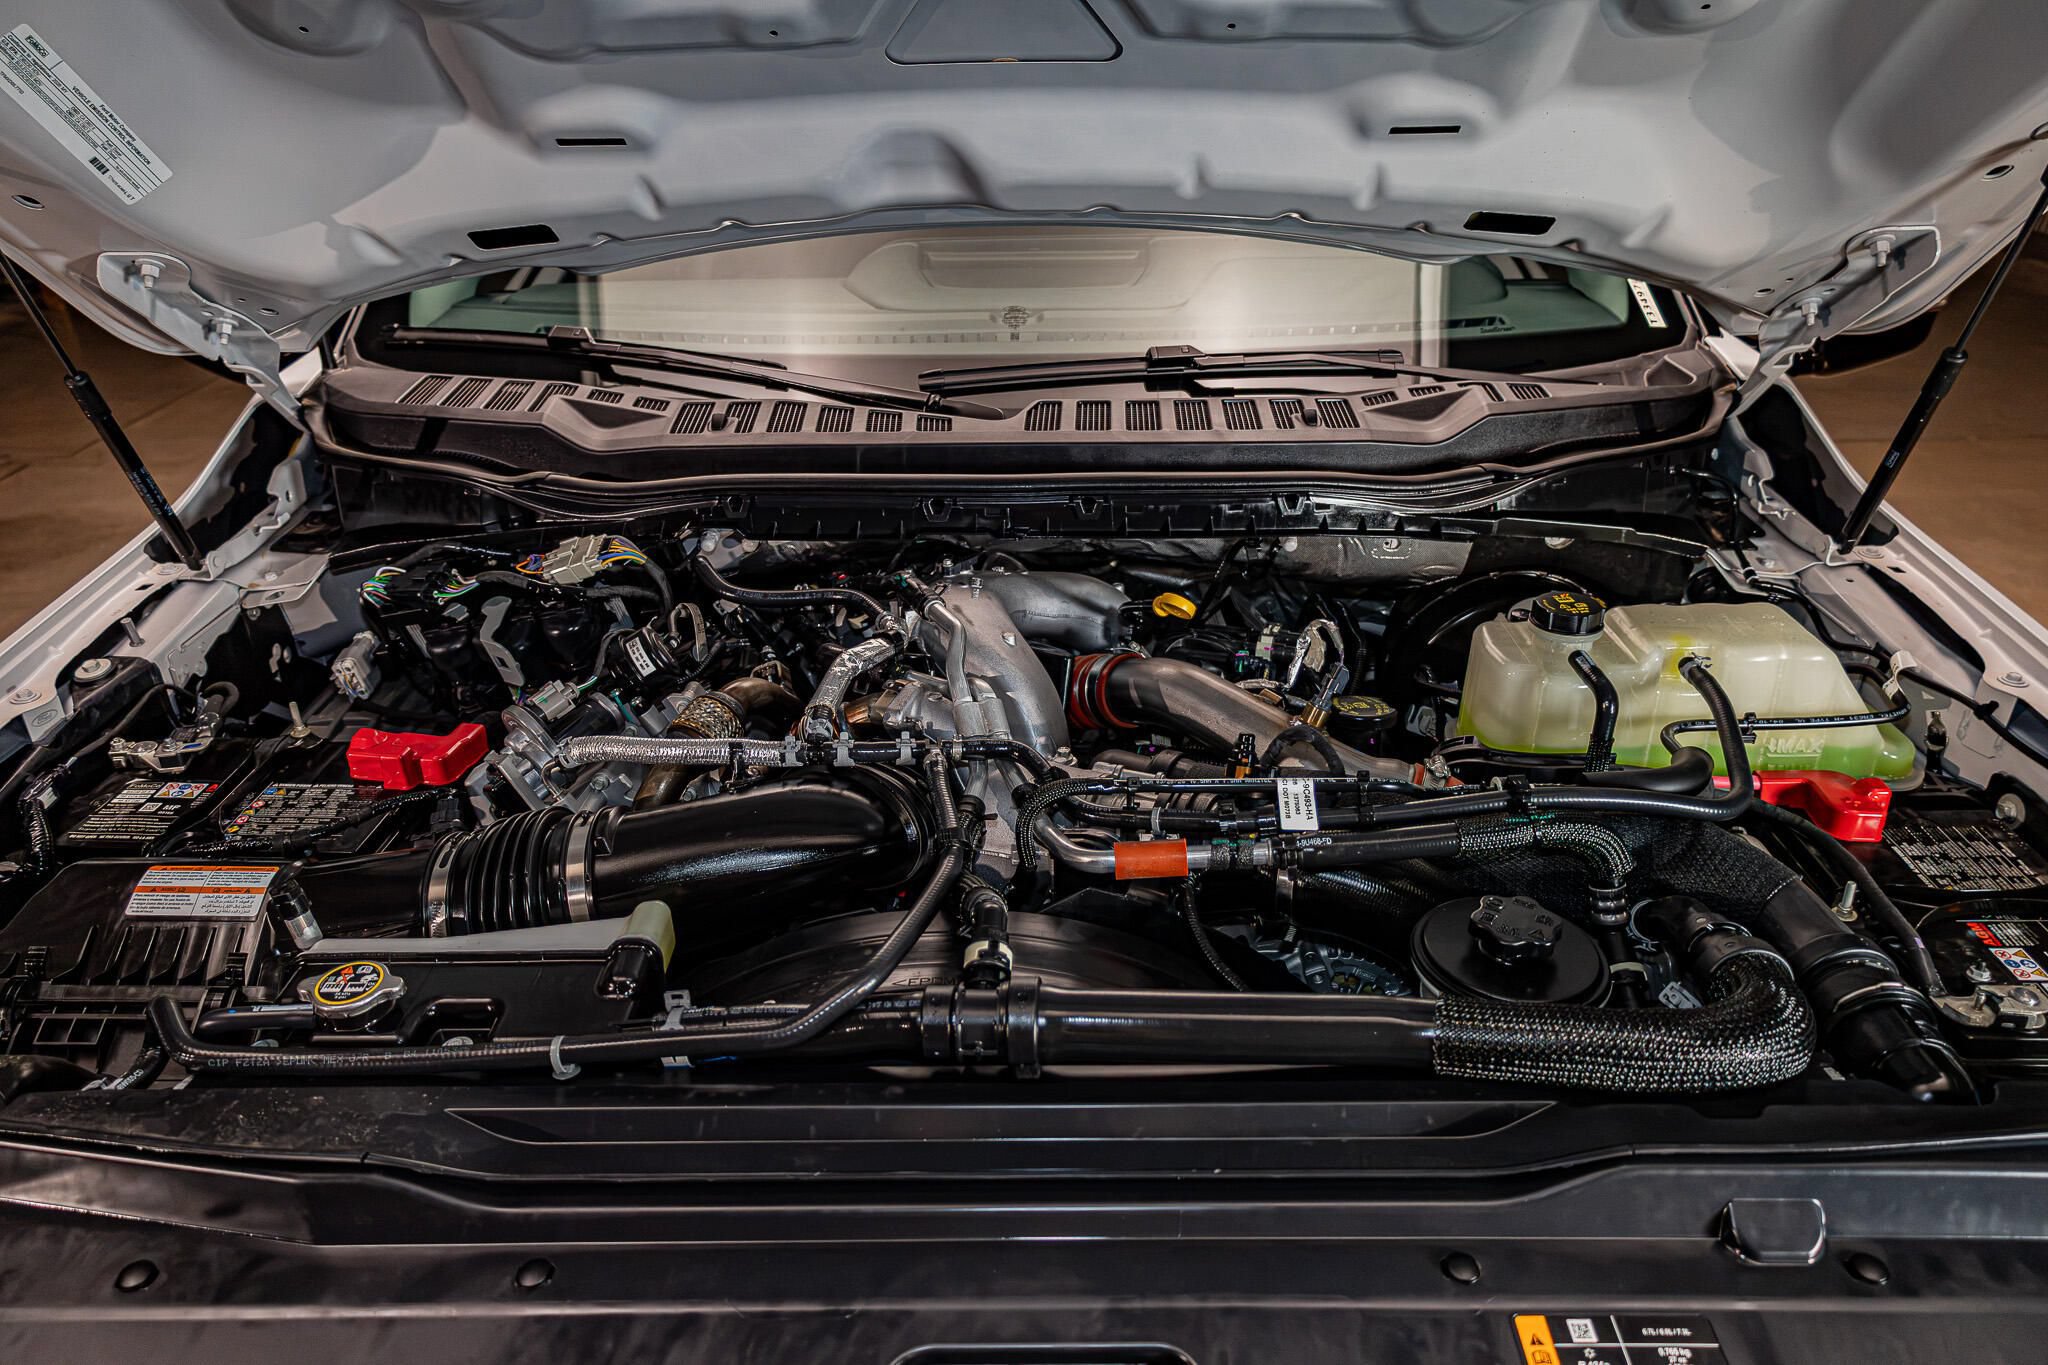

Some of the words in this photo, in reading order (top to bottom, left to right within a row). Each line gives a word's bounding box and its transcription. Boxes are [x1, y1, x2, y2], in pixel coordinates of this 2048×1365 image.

[25, 34, 48, 57] FoMoCo
[72, 85, 90, 104] VEHICLE
[89, 103, 109, 123] EMISSION
[108, 122, 126, 141] CONTROL
[125, 139, 150, 165] INFORMATION
[99, 103, 110, 114] Ford
[108, 112, 120, 125] Motor
[118, 123, 137, 142] Company
[1776, 737, 1824, 754] MAX
